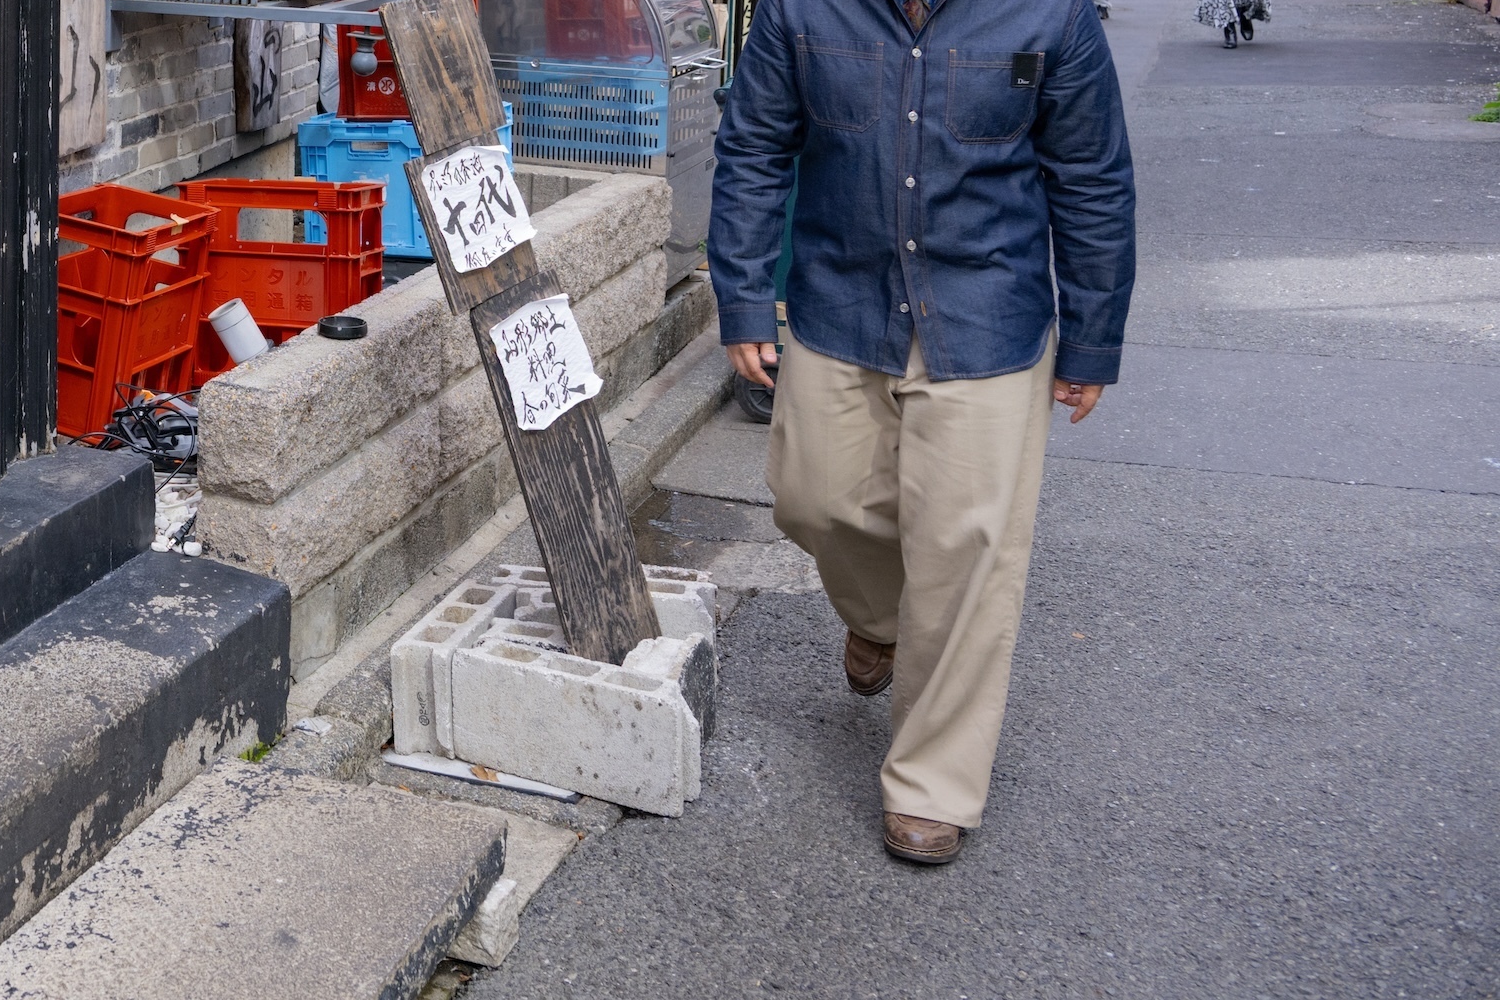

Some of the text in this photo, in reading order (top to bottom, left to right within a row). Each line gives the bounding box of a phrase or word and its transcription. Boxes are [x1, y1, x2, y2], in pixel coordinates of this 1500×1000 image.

[443, 164, 517, 250] 十四代
[213, 265, 314, 286] レンタル
